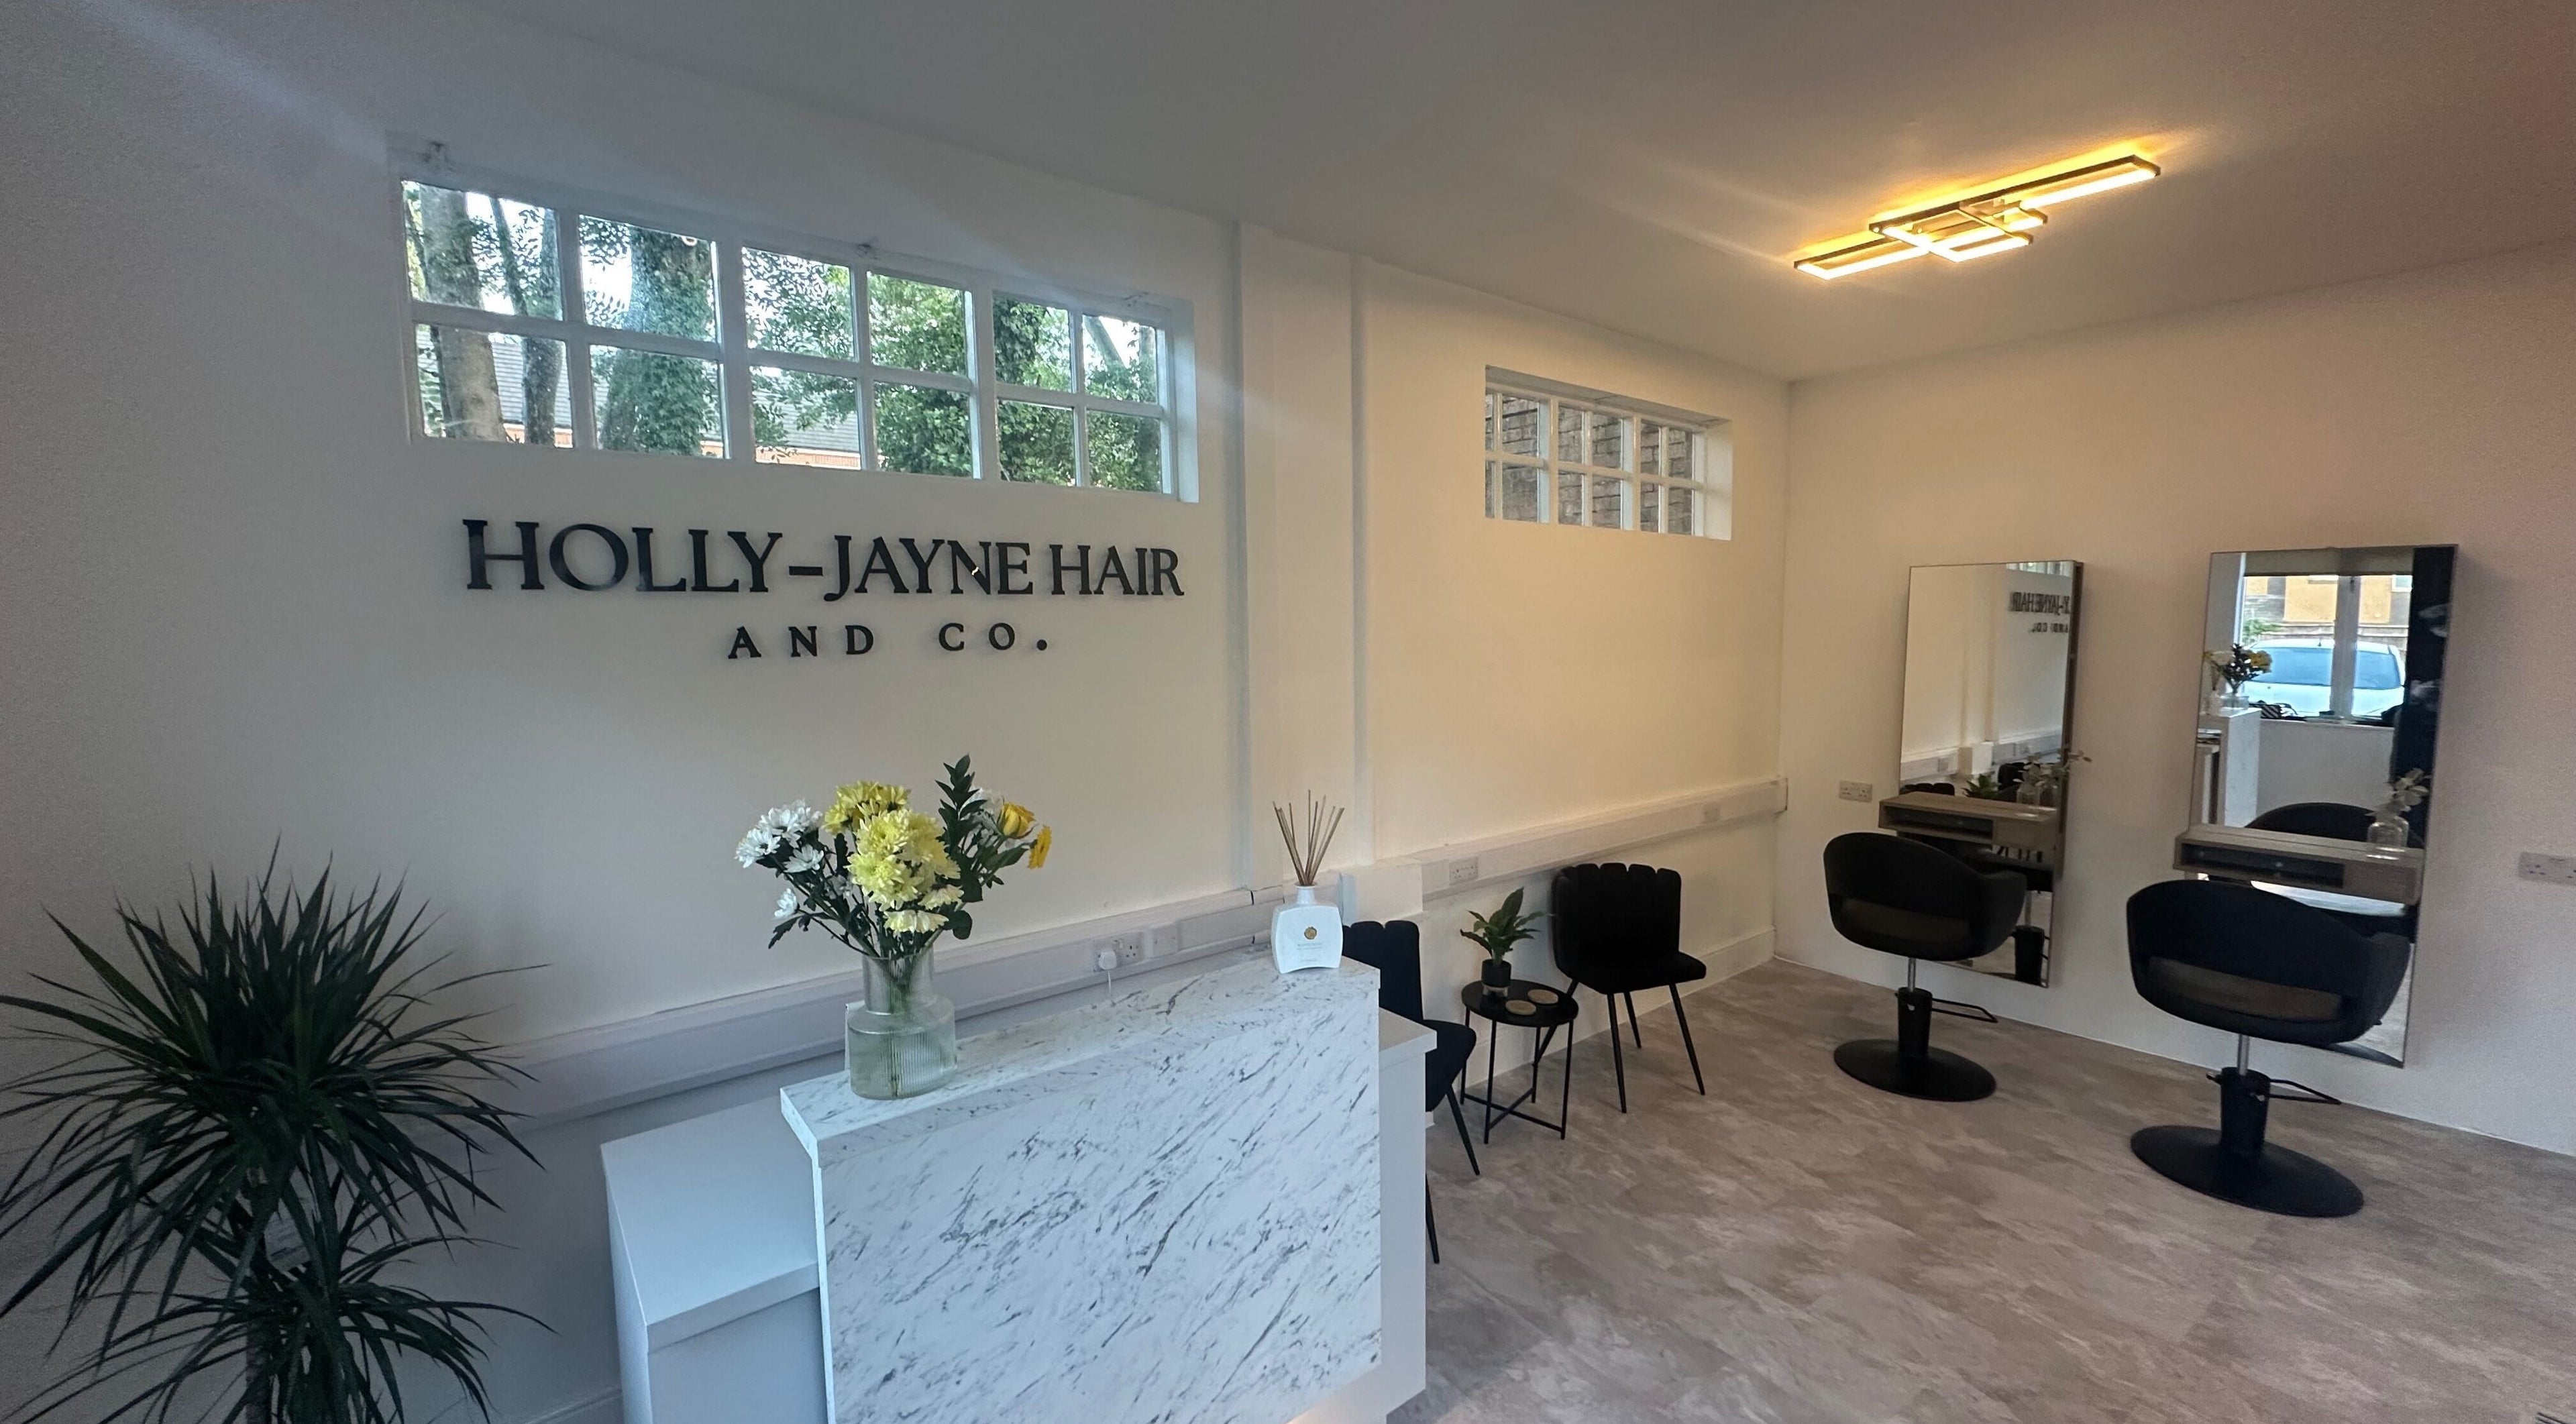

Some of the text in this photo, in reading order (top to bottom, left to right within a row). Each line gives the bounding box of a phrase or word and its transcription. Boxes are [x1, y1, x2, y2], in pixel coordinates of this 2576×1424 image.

[462, 518, 1185, 603] HOLLY-JAYNE HAIR
[727, 622, 1049, 661] AND CO.
